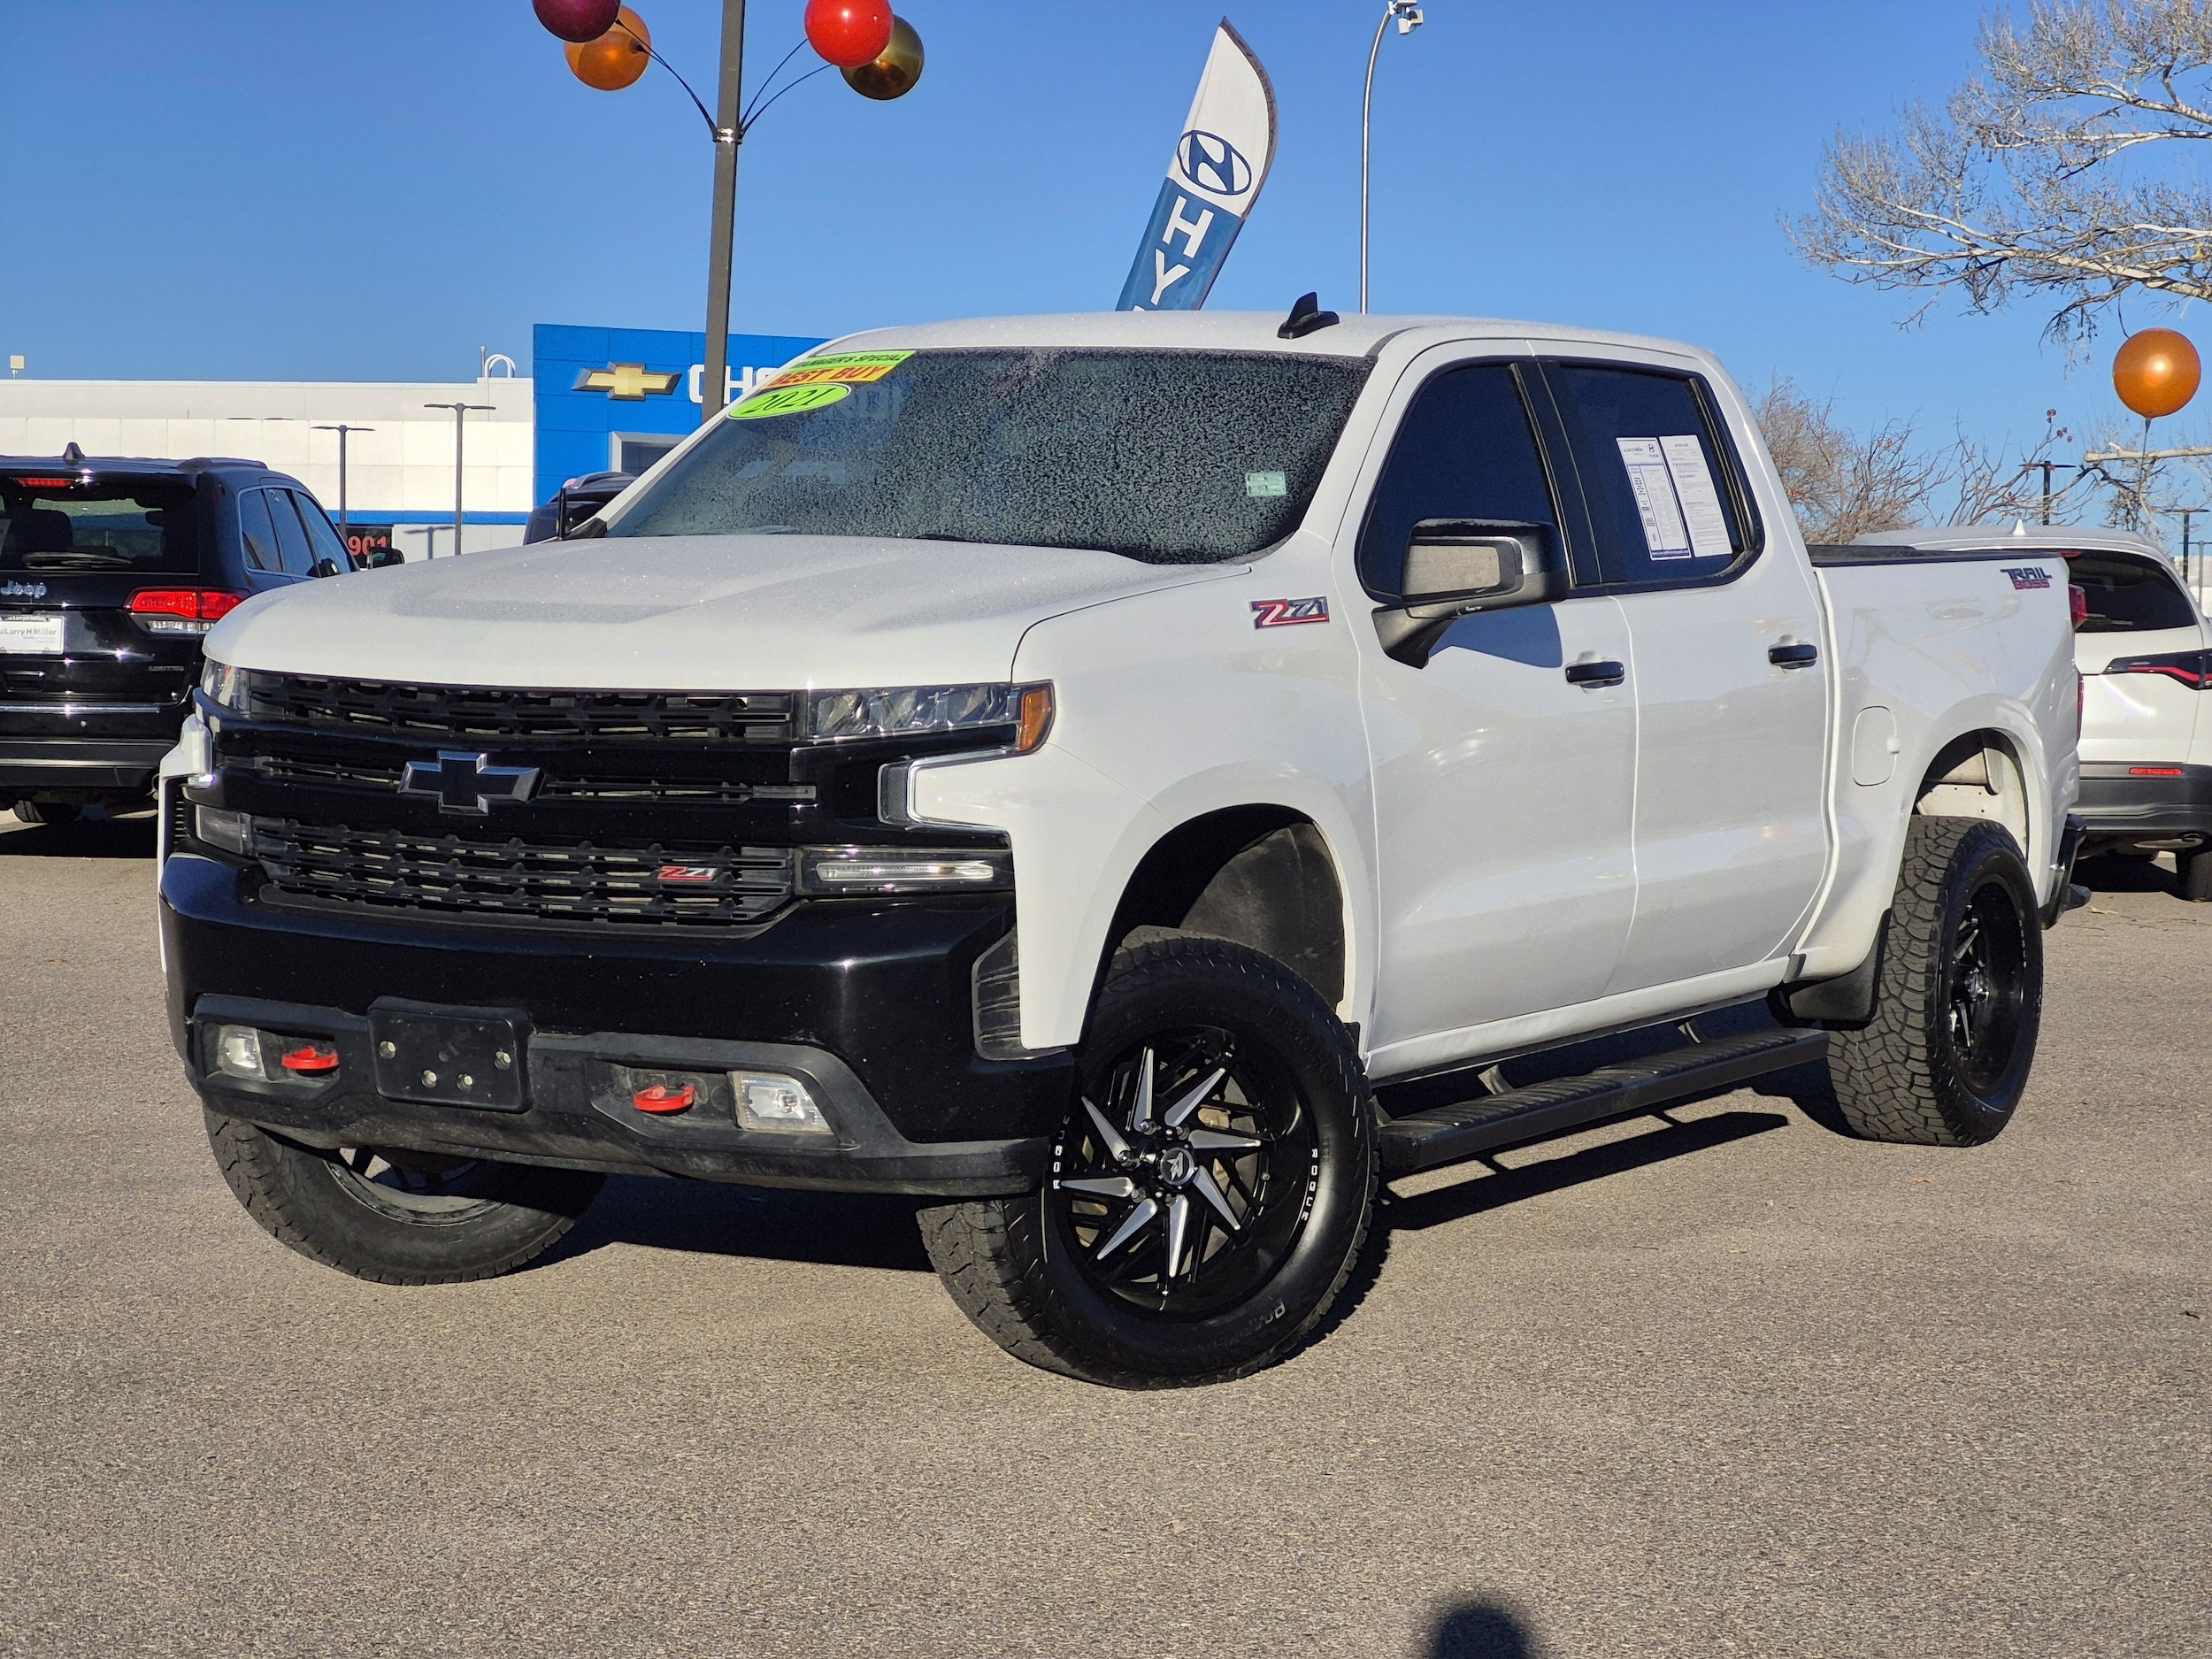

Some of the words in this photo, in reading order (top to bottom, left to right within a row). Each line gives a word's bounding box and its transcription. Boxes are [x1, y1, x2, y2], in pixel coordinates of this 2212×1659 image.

[1133, 195, 1215, 311] HY
[855, 354, 906, 363] SPECIAL
[766, 368, 834, 387] BEST
[828, 366, 887, 380] BUY
[740, 387, 838, 415] 2021
[2000, 567, 2053, 580] TRAIL
[0, 580, 48, 600] Jeep
[2013, 579, 2050, 589] BOSS
[1249, 596, 1330, 630] Z71
[657, 865, 718, 880] Z71
[1301, 1148, 1318, 1221] ROGUE
